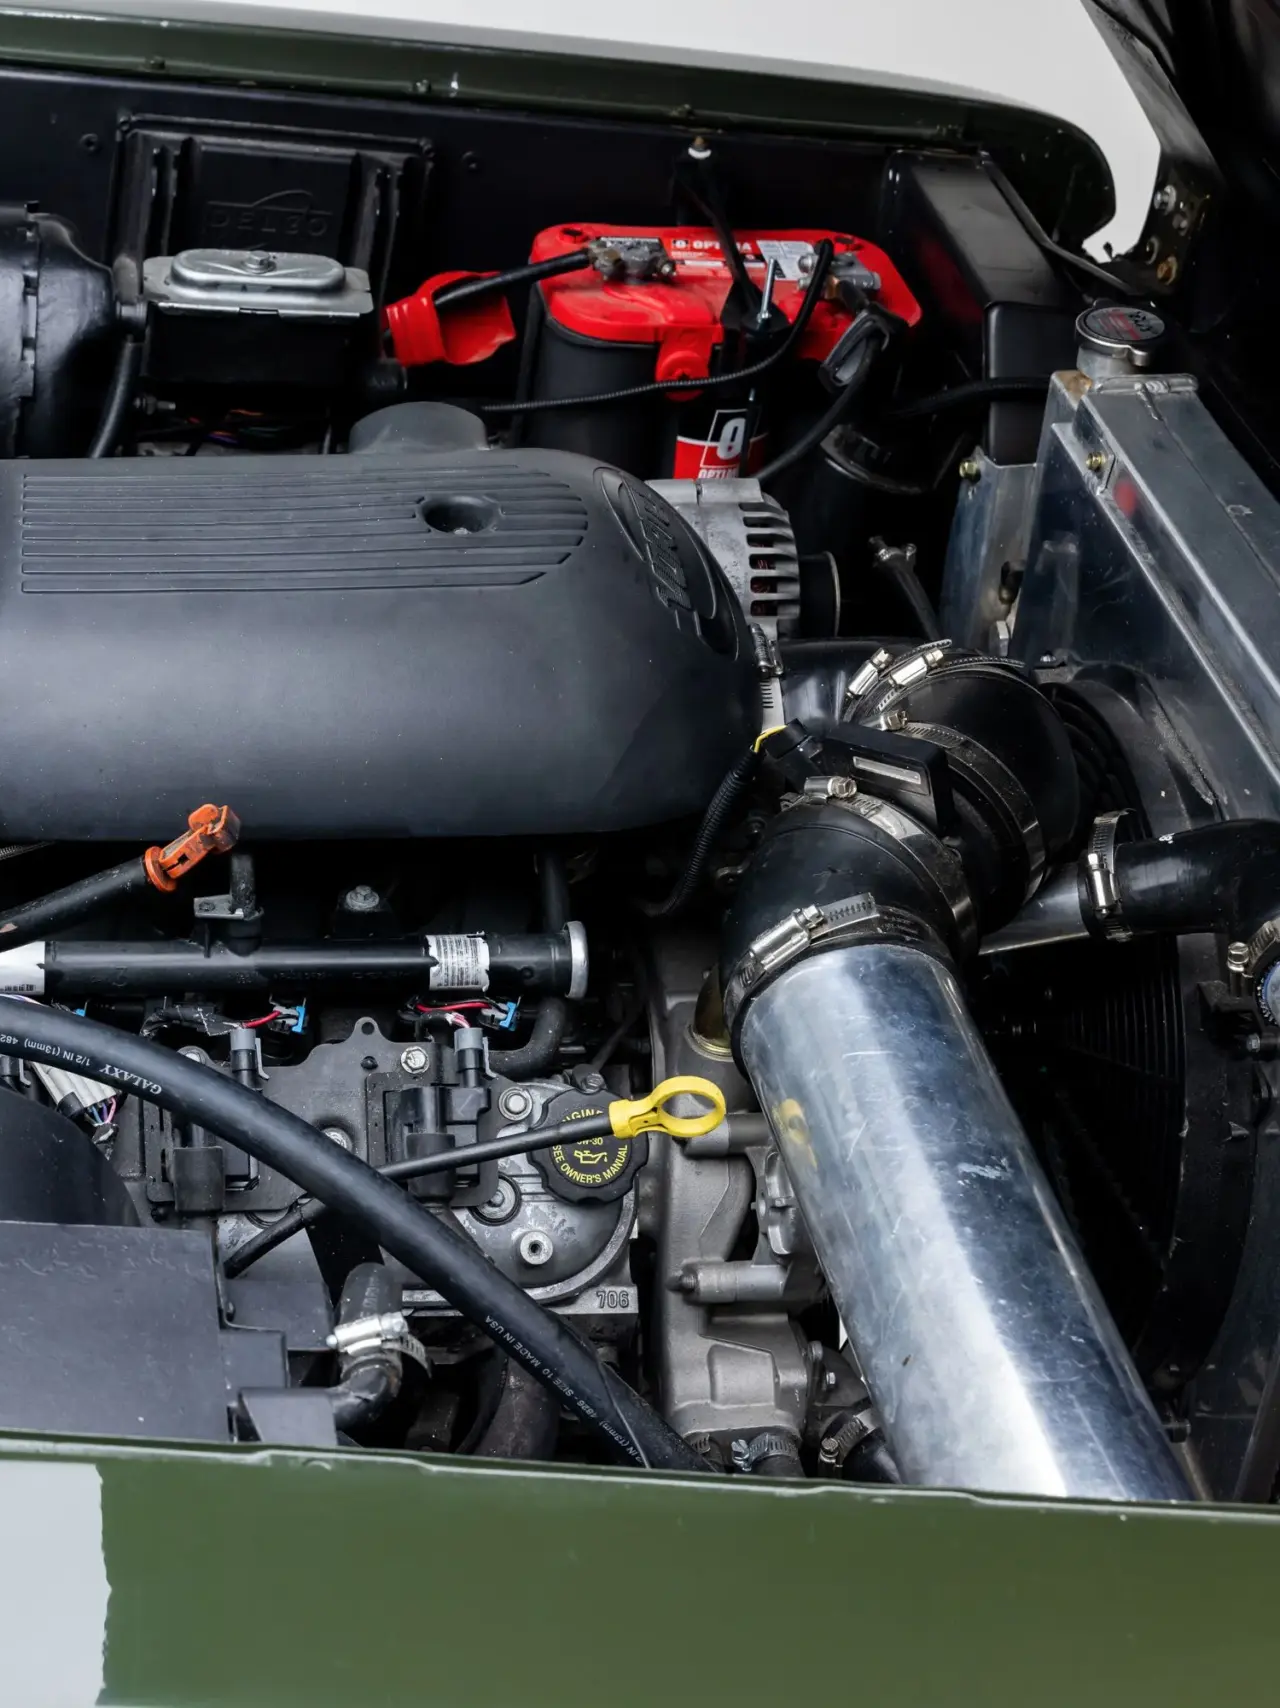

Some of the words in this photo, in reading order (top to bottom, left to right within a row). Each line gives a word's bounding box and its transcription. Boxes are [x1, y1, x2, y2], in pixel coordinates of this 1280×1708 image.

[24, 1038, 61, 1057] (13mm)
[62, 1050, 75, 1061] IN
[76, 1054, 91, 1067] 1/2
[99, 1063, 162, 1095] GALAXY
[552, 1144, 565, 1164] SEE
[560, 1162, 602, 1184] OWNER'S
[602, 1144, 628, 1180] MANUAL
[596, 1290, 629, 1308] 706
[485, 1315, 504, 1334] USA
[503, 1332, 516, 1344] IN
[513, 1341, 540, 1367] MADE
[542, 1368, 554, 1379] 10
[553, 1378, 575, 1397] SIZE
[576, 1399, 598, 1419] 4826
[599, 1420, 630, 1448] (13mm)
